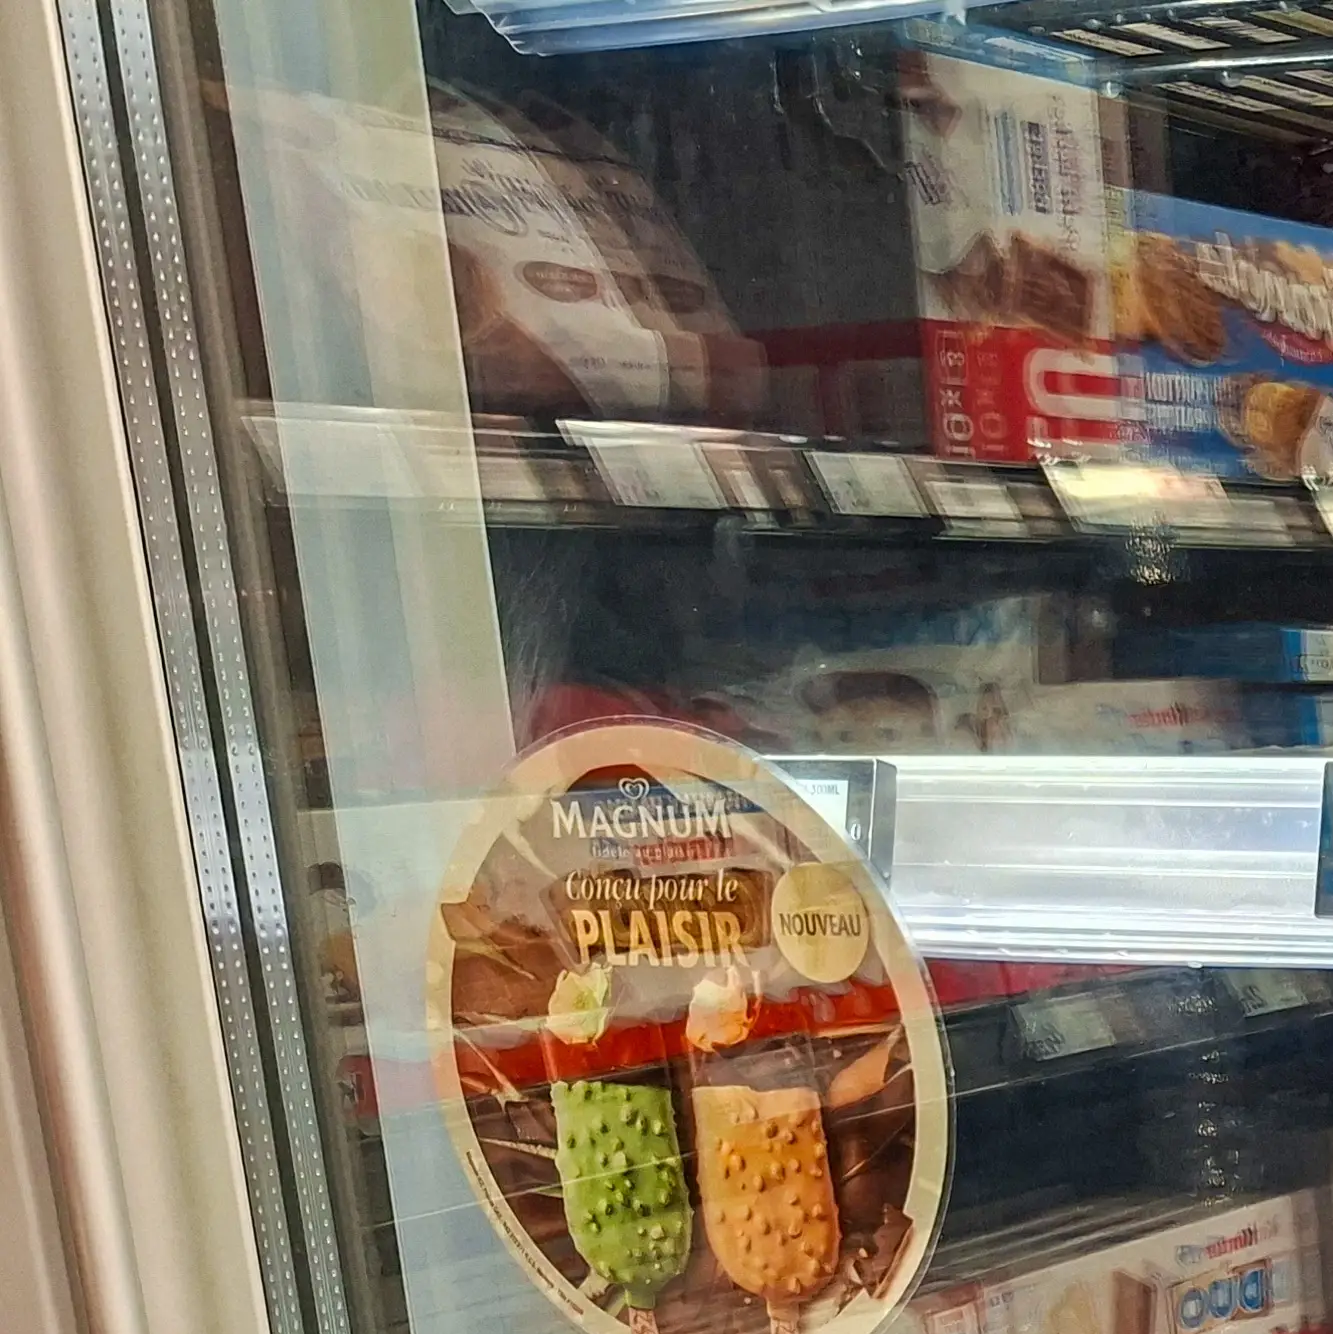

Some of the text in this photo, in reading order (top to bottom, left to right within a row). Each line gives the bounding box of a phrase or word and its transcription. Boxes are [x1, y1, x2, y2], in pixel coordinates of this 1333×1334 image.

[552, 799, 733, 839] MAGNUM
[566, 868, 739, 910] Conçu pour le
[571, 909, 750, 969] PLAISIR
[779, 912, 861, 937] NOUVEAU
